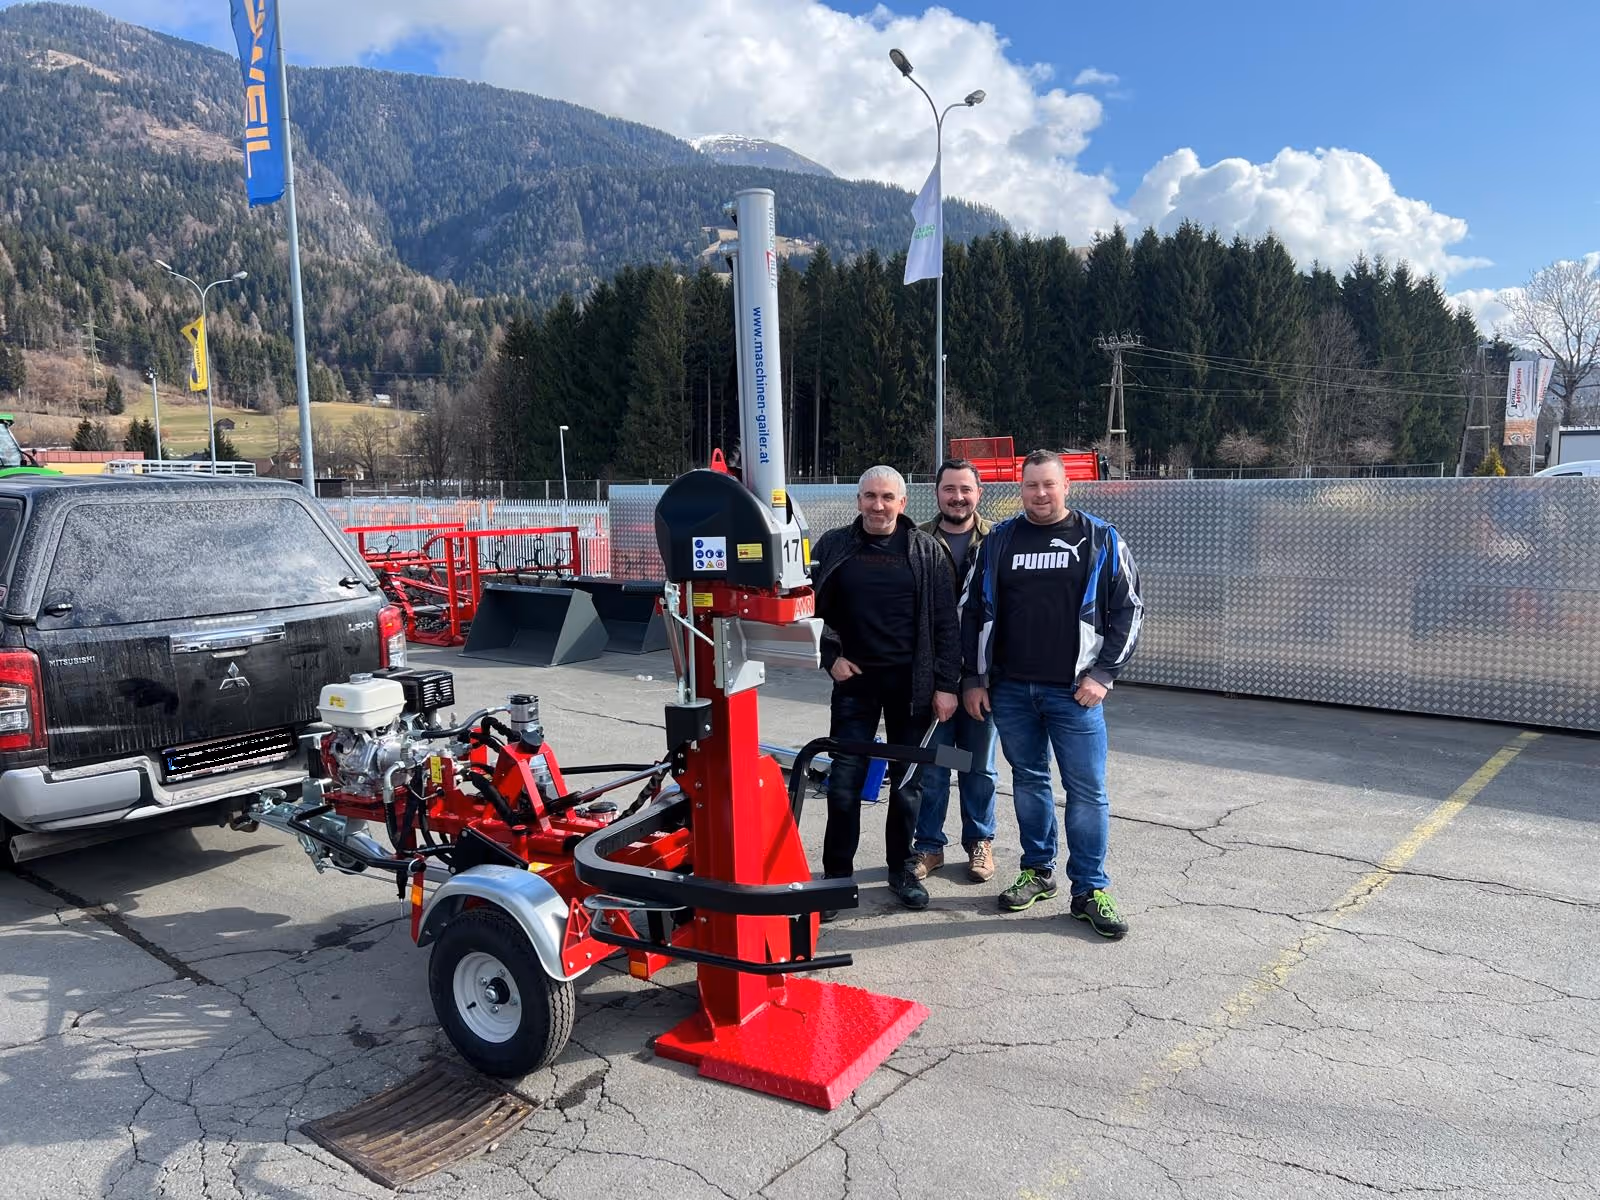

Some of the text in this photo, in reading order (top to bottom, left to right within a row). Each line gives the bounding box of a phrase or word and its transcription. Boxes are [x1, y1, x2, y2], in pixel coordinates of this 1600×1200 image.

[753, 306, 770, 464] www.maschinen-gailer.at
[783, 538, 800, 563] 17
[1011, 551, 1070, 571] PUMA
[348, 620, 374, 633] L200
[48, 655, 96, 668] MITSUBISHI
